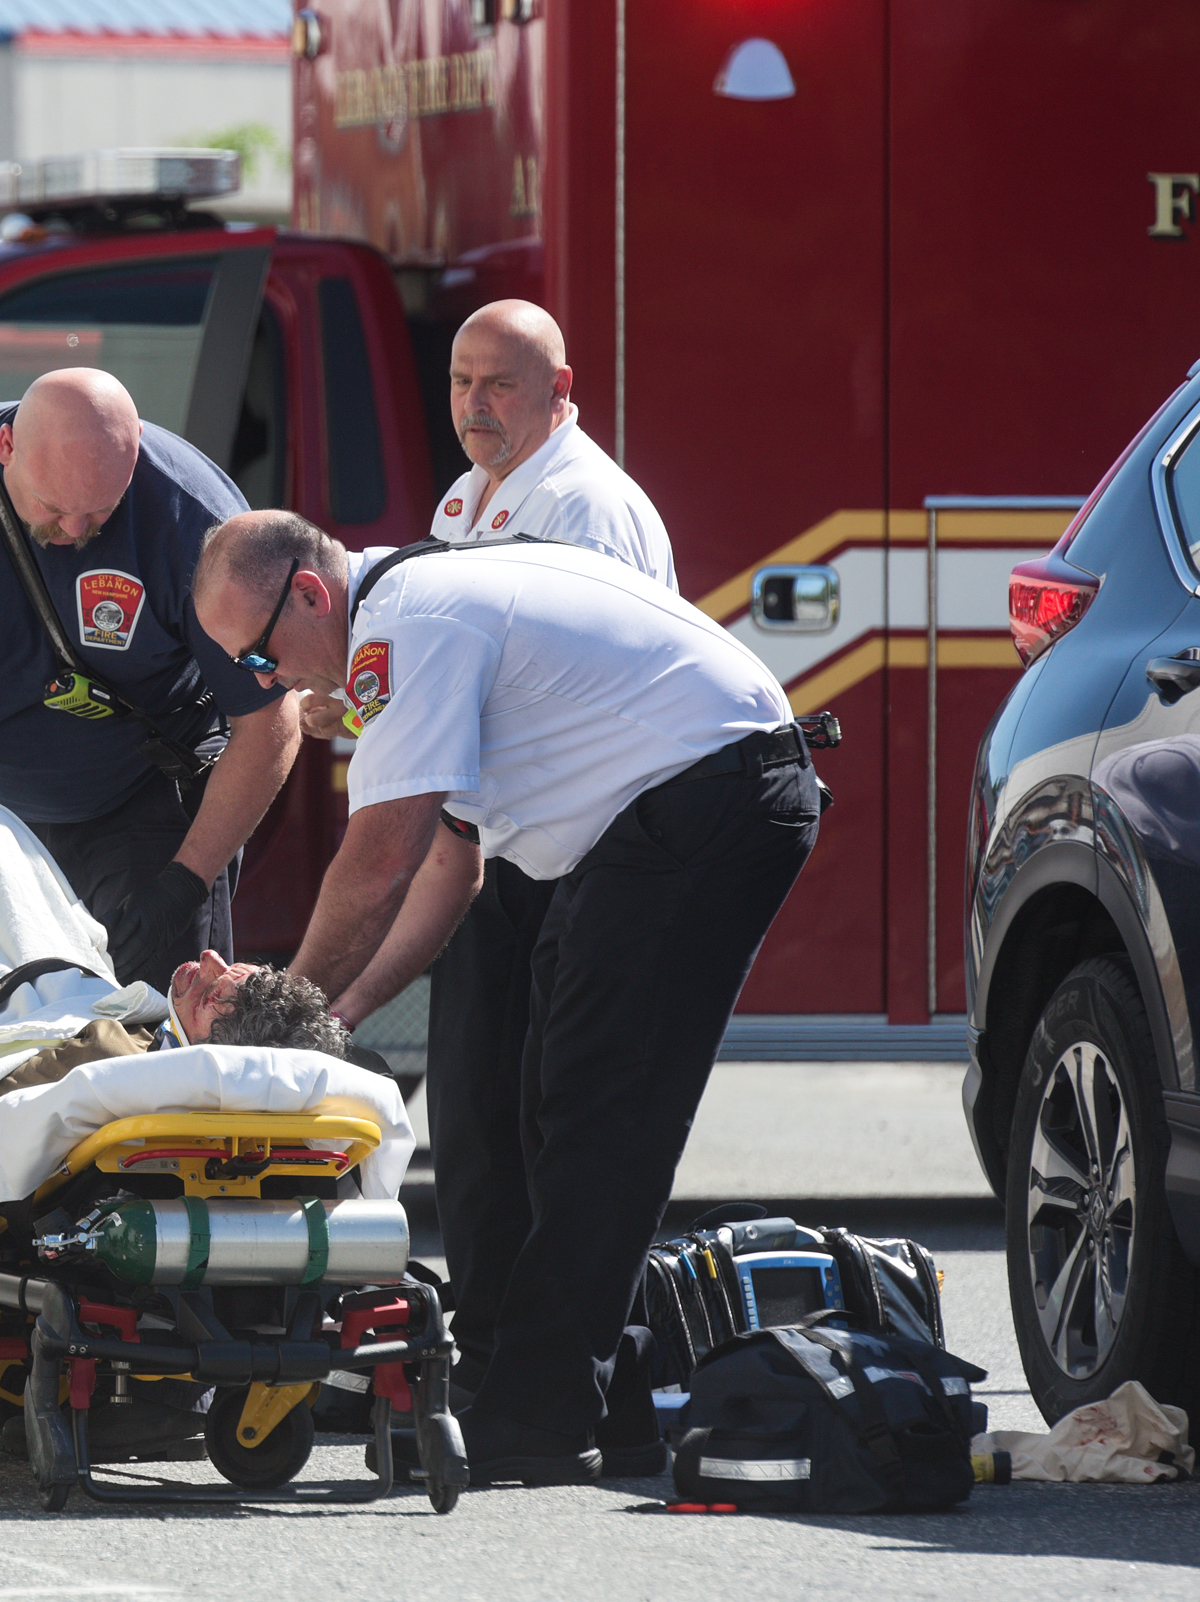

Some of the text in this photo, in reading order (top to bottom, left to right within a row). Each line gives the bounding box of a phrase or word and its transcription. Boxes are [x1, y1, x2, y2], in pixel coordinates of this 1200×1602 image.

[84, 579, 139, 597] LEBANON
[86, 635, 126, 645] DEPARTMENT
[94, 628, 118, 640] FIRE
[363, 699, 381, 713] FIRE
